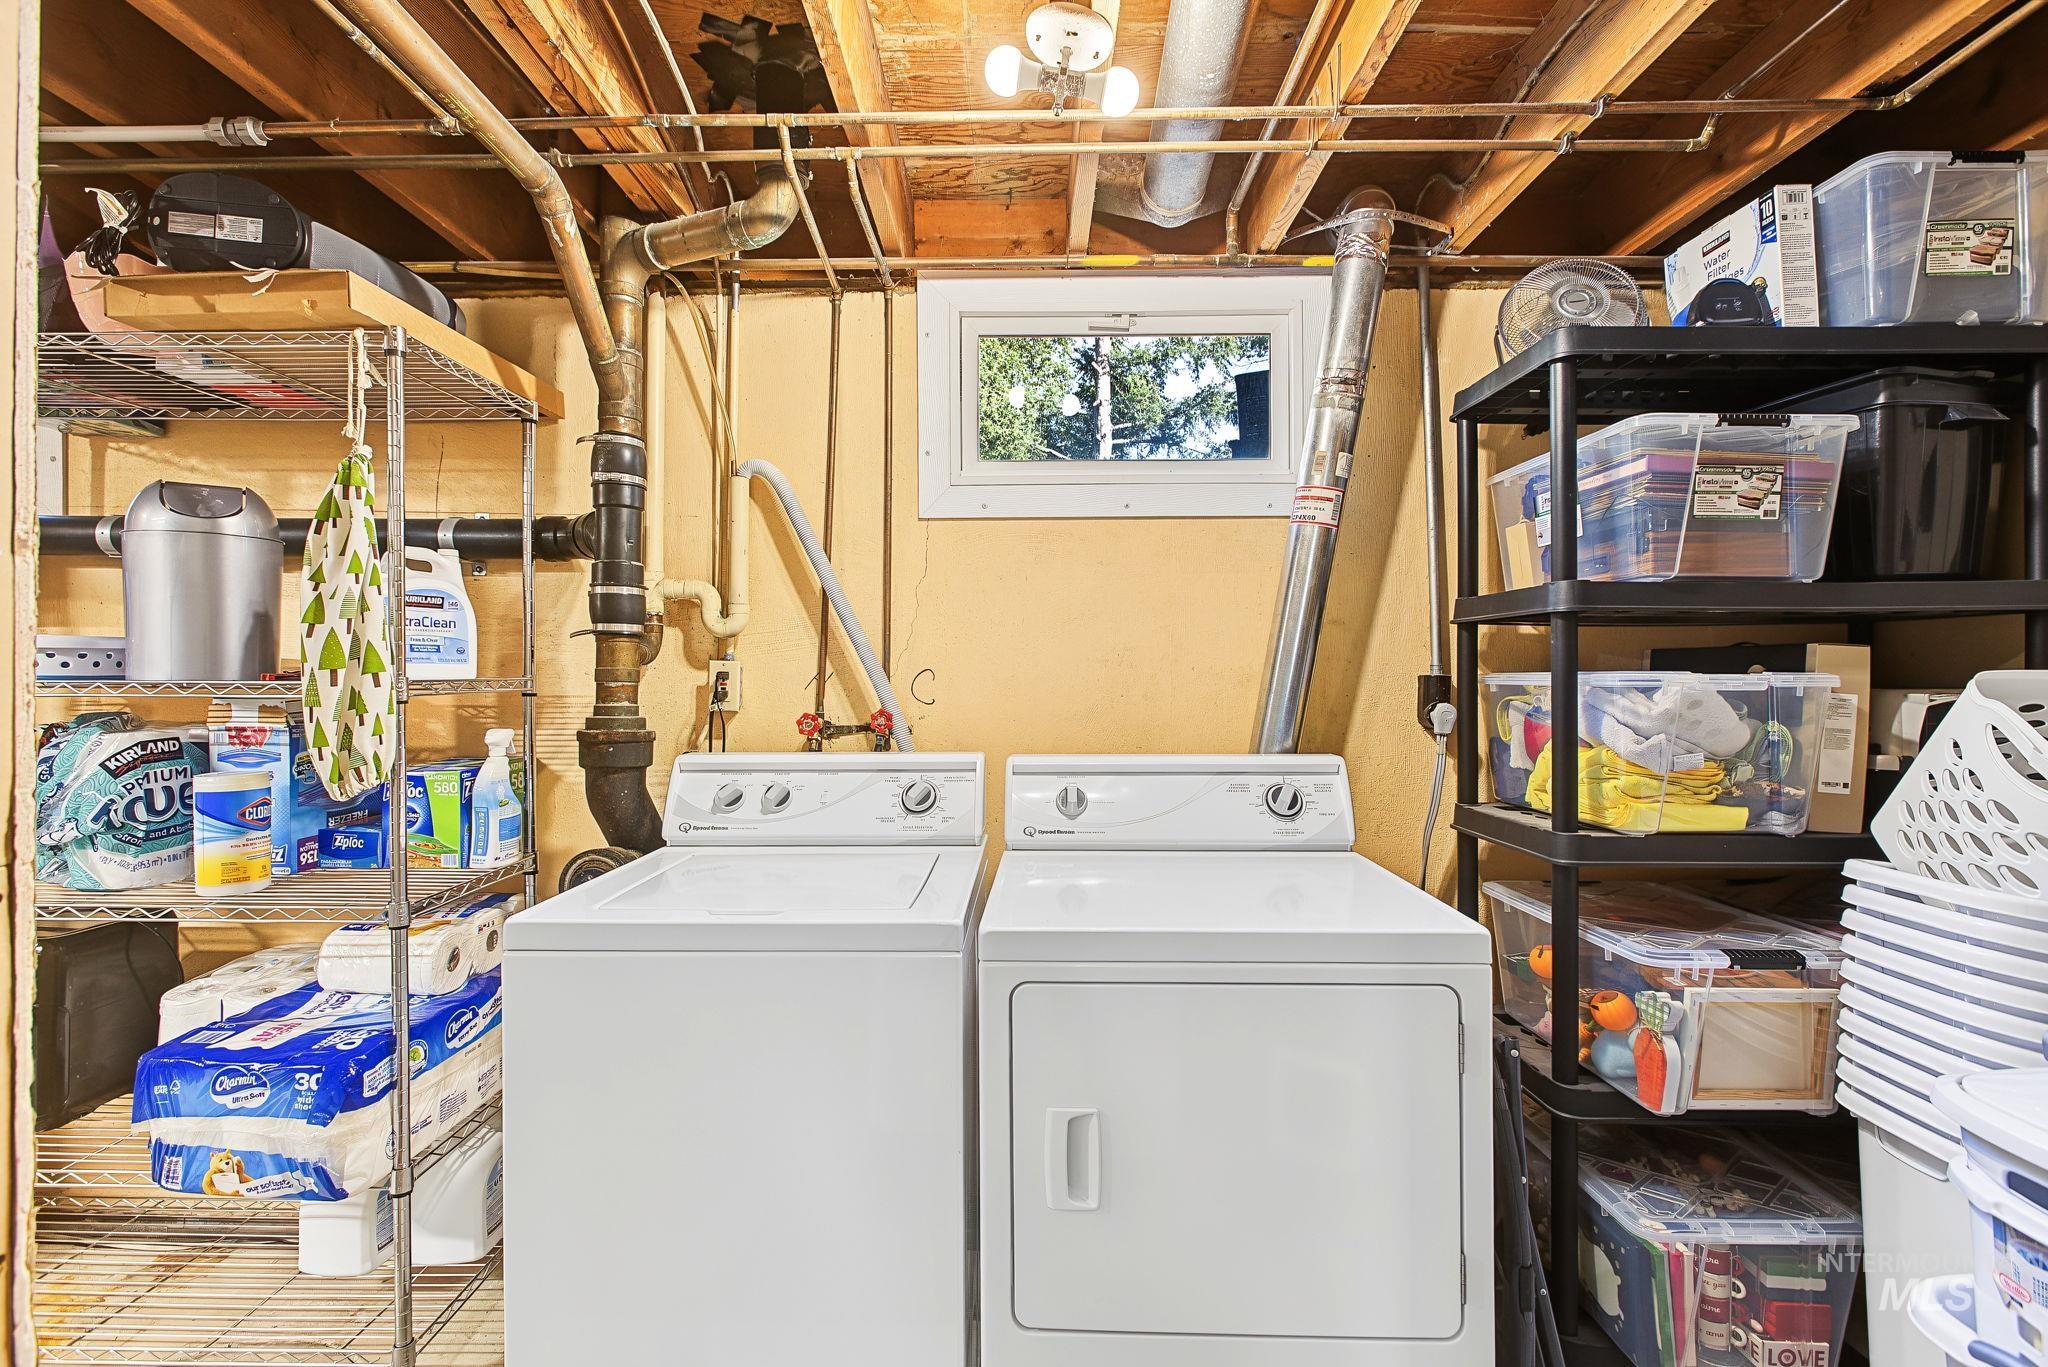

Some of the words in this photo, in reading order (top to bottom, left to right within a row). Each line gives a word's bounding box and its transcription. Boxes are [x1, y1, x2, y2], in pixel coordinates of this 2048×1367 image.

[1760, 198, 1773, 220] 10
[1703, 249, 1730, 271] Water
[1707, 261, 1731, 281] Filter
[433, 781, 458, 794] 580
[328, 809, 369, 826] FREEZER
[149, 829, 167, 838] and
[334, 835, 365, 851] Ziploc
[300, 850, 318, 866] 136
[215, 1075, 257, 1092] Charmin
[232, 1096, 249, 1104] Ultra
[249, 1092, 265, 1100] Soft
[1768, 1348, 1826, 1367] LOVE
